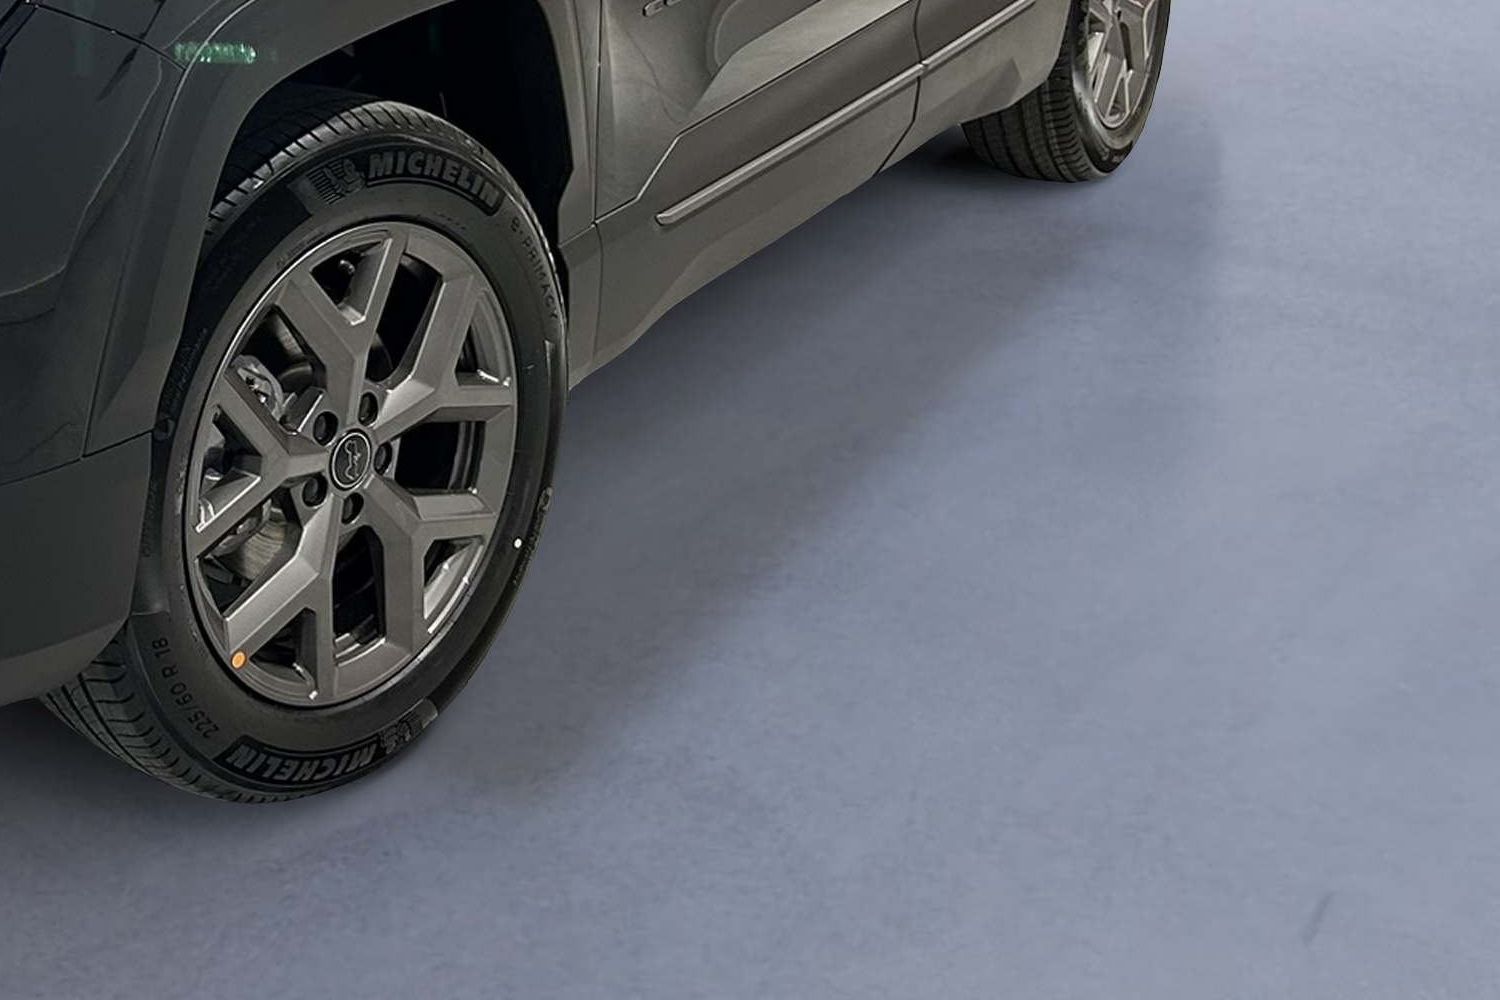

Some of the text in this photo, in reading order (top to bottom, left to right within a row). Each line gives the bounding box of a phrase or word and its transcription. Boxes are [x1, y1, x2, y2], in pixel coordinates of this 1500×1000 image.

[368, 150, 501, 209] MICHELIN
[151, 636, 220, 739] 225/60 R 18
[225, 744, 377, 782] MICHELIN
